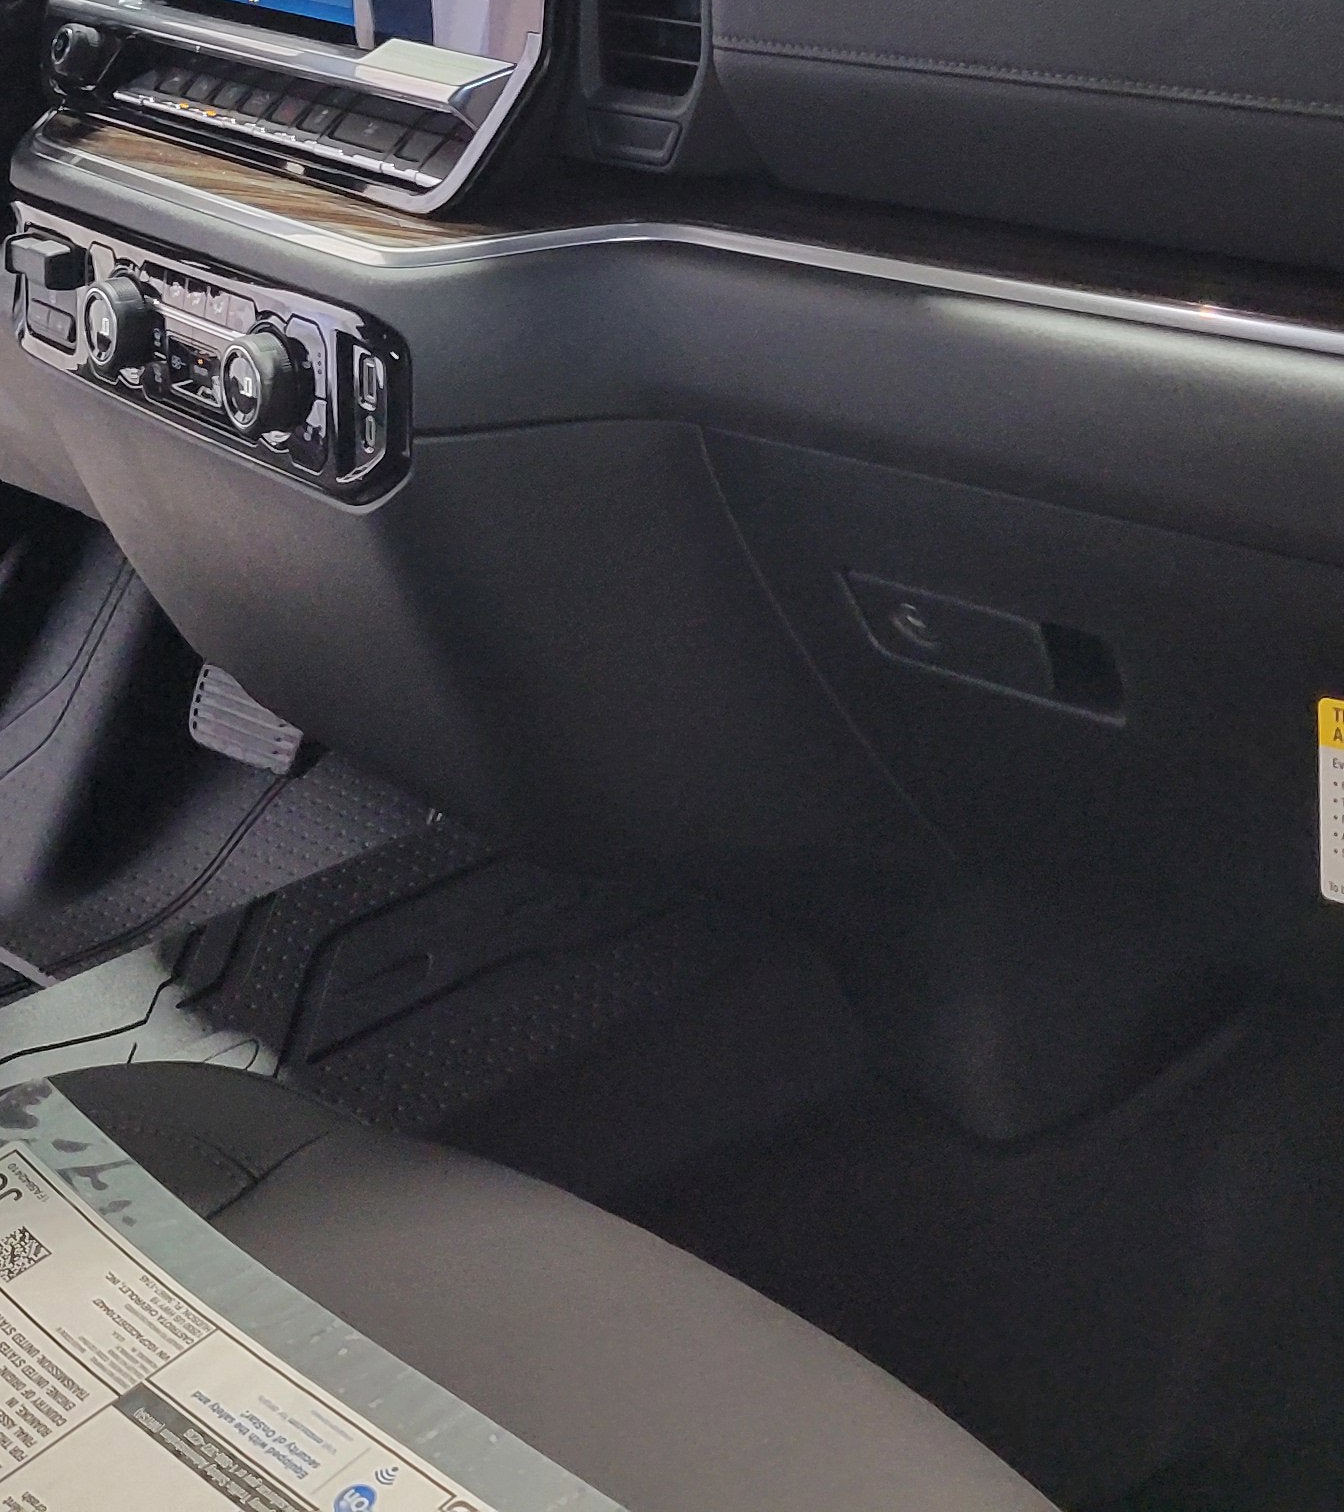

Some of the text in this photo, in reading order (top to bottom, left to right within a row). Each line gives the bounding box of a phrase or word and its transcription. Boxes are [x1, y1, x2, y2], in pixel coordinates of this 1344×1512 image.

[1329, 881, 1338, 892] To
[103, 1271, 121, 1285] INC.
[116, 1282, 160, 1316] CHEVROLET,
[157, 1302, 177, 1317] HWY
[155, 1314, 195, 1345] CASTRIOTA
[172, 1314, 187, 1324] US
[11, 1331, 42, 1357] UNITED
[154, 1350, 170, 1361] VIN
[19, 1363, 51, 1388] UNITED
[35, 1353, 91, 1401] TRANSMISSION:
[4, 1396, 19, 1407] IN
[19, 1386, 37, 1399] OF
[43, 1384, 77, 1411] ENGINE:
[12, 1404, 52, 1438] ROANOKE,
[30, 1396, 68, 1427] COUNTRY
[10, 1426, 37, 1448] FINAL
[190, 1390, 312, 1480] Equipped with the safety and
[7, 1445, 28, 1462] FOR
[272, 1434, 323, 1470] security of
[342, 1489, 370, 1511] On
